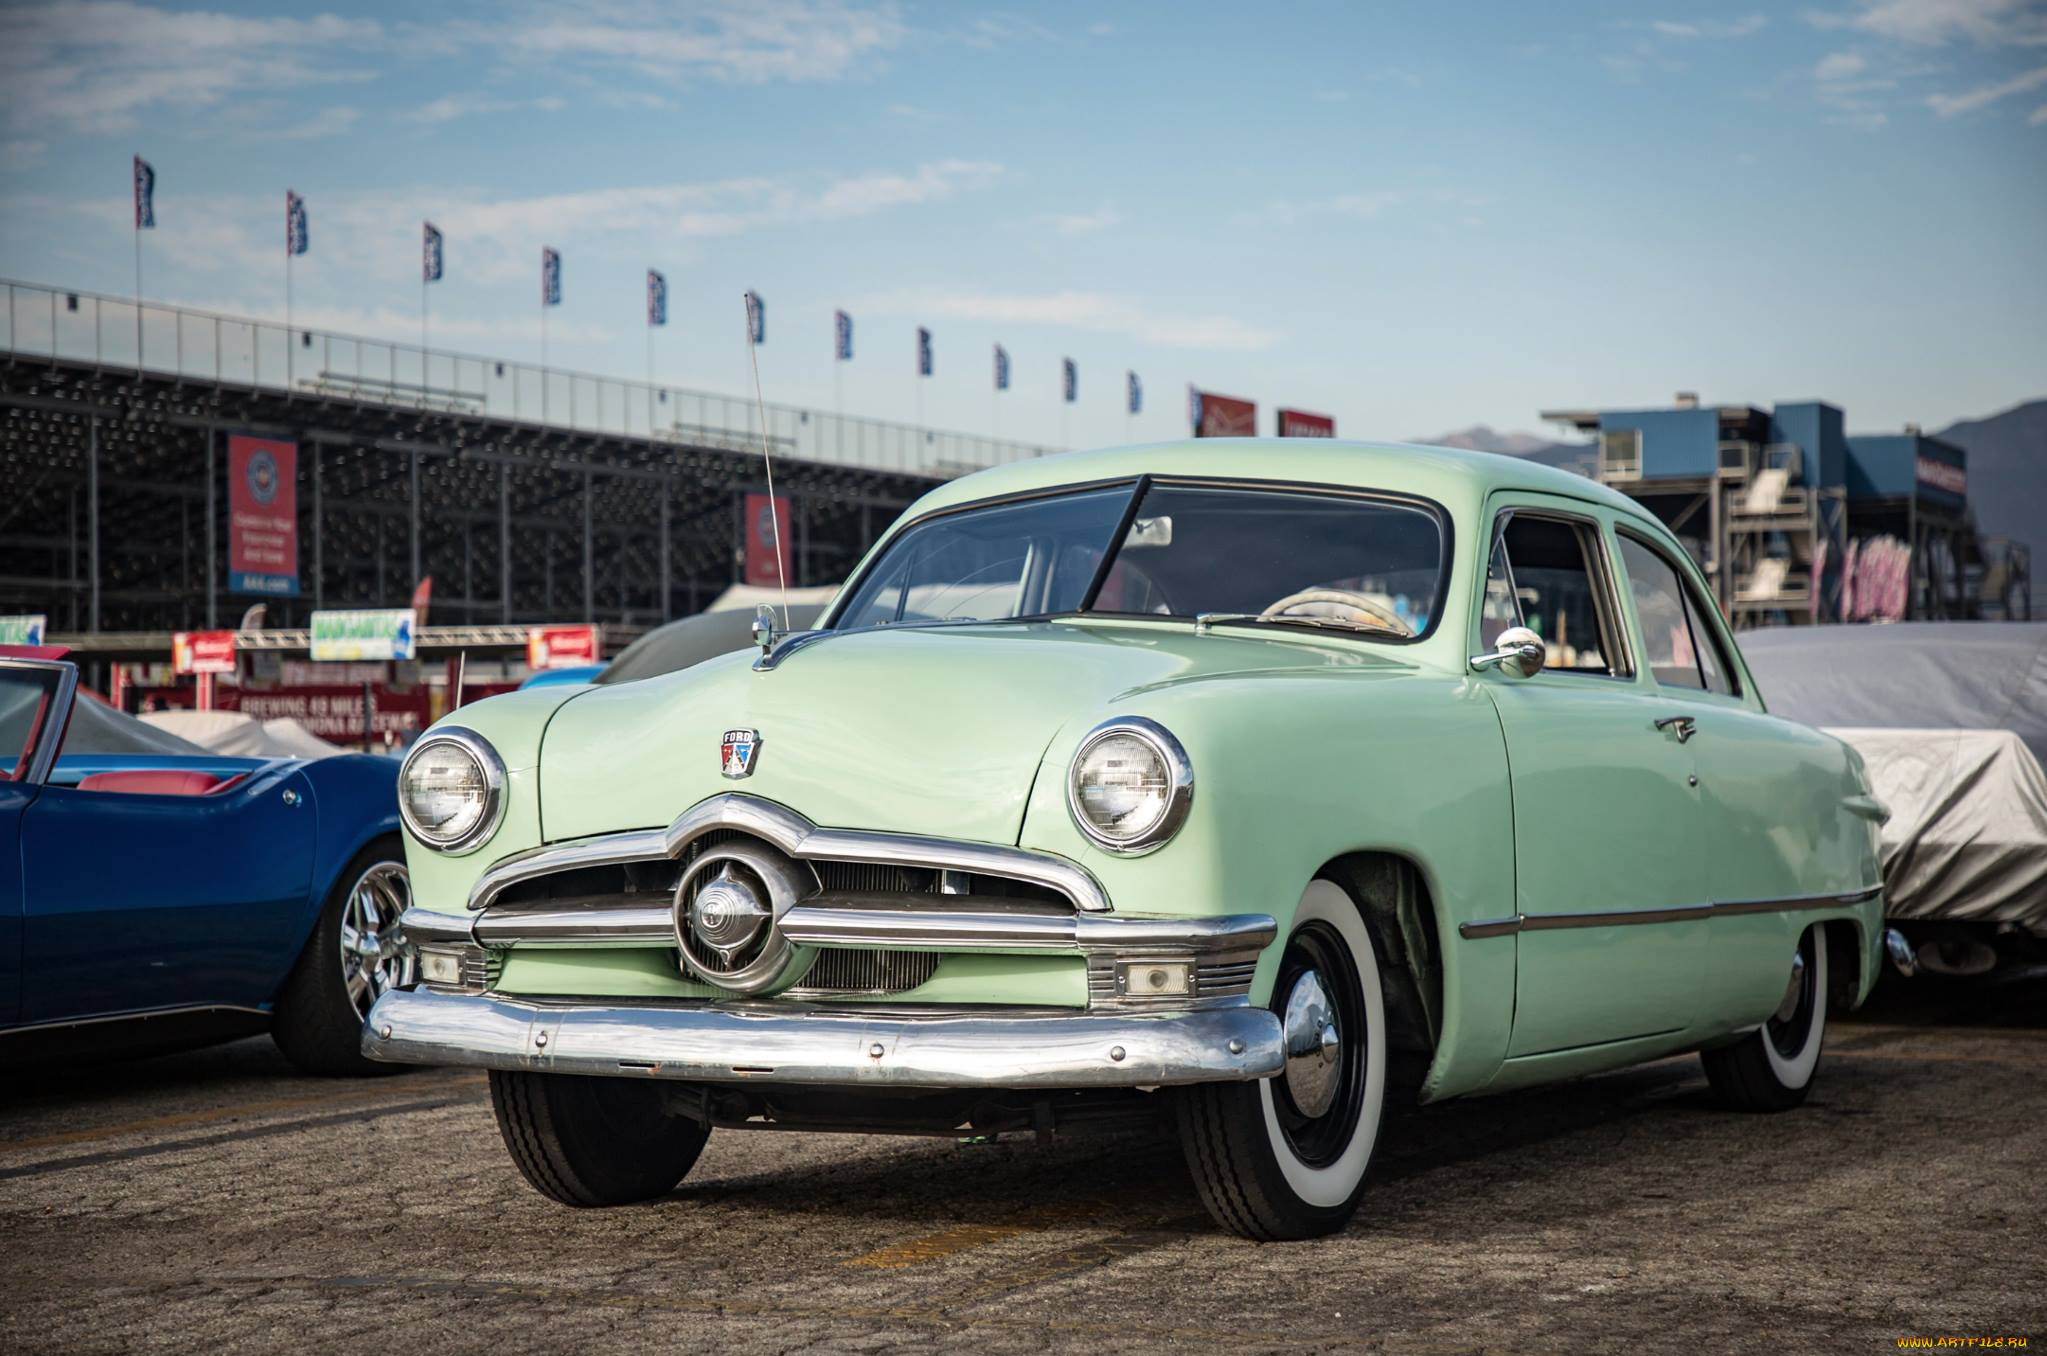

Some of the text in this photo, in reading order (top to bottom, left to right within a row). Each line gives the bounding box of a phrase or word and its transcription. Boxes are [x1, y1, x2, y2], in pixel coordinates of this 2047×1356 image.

[241, 695, 307, 717] BREWING
[309, 695, 328, 716] 49
[724, 731, 751, 742] FORD
